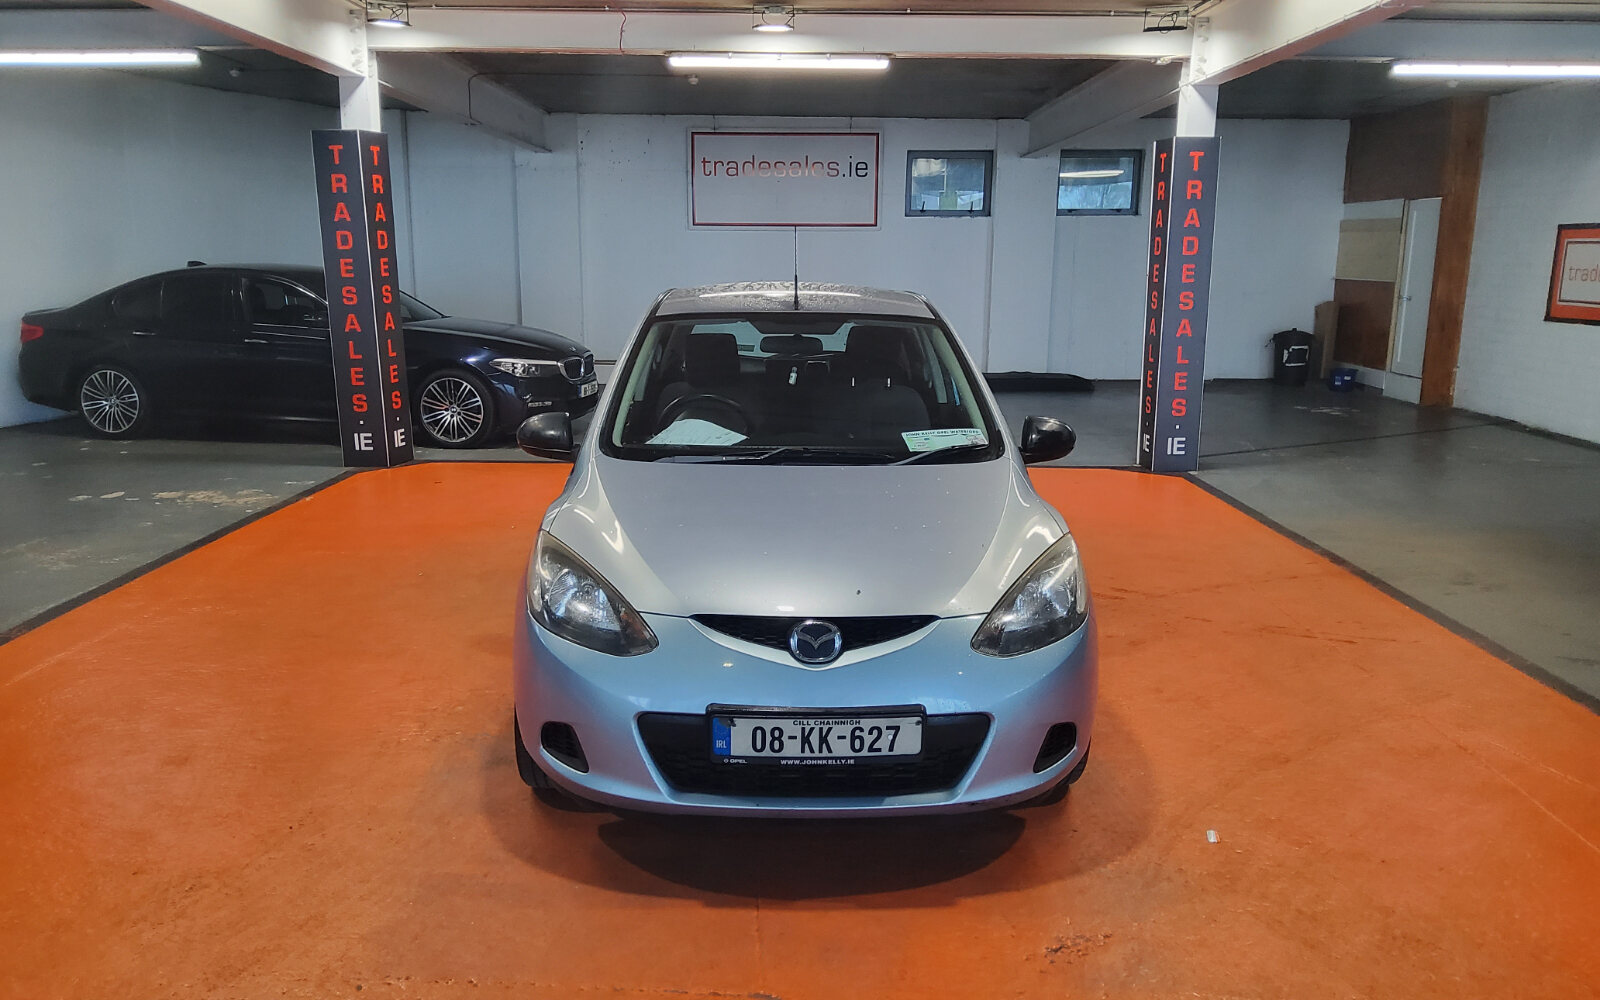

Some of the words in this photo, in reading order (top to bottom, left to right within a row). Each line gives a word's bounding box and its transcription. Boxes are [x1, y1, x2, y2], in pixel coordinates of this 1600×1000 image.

[701, 154, 869, 178] tradesales.ie
[716, 739, 727, 748] IRL
[751, 725, 901, 754] 08-KK-627
